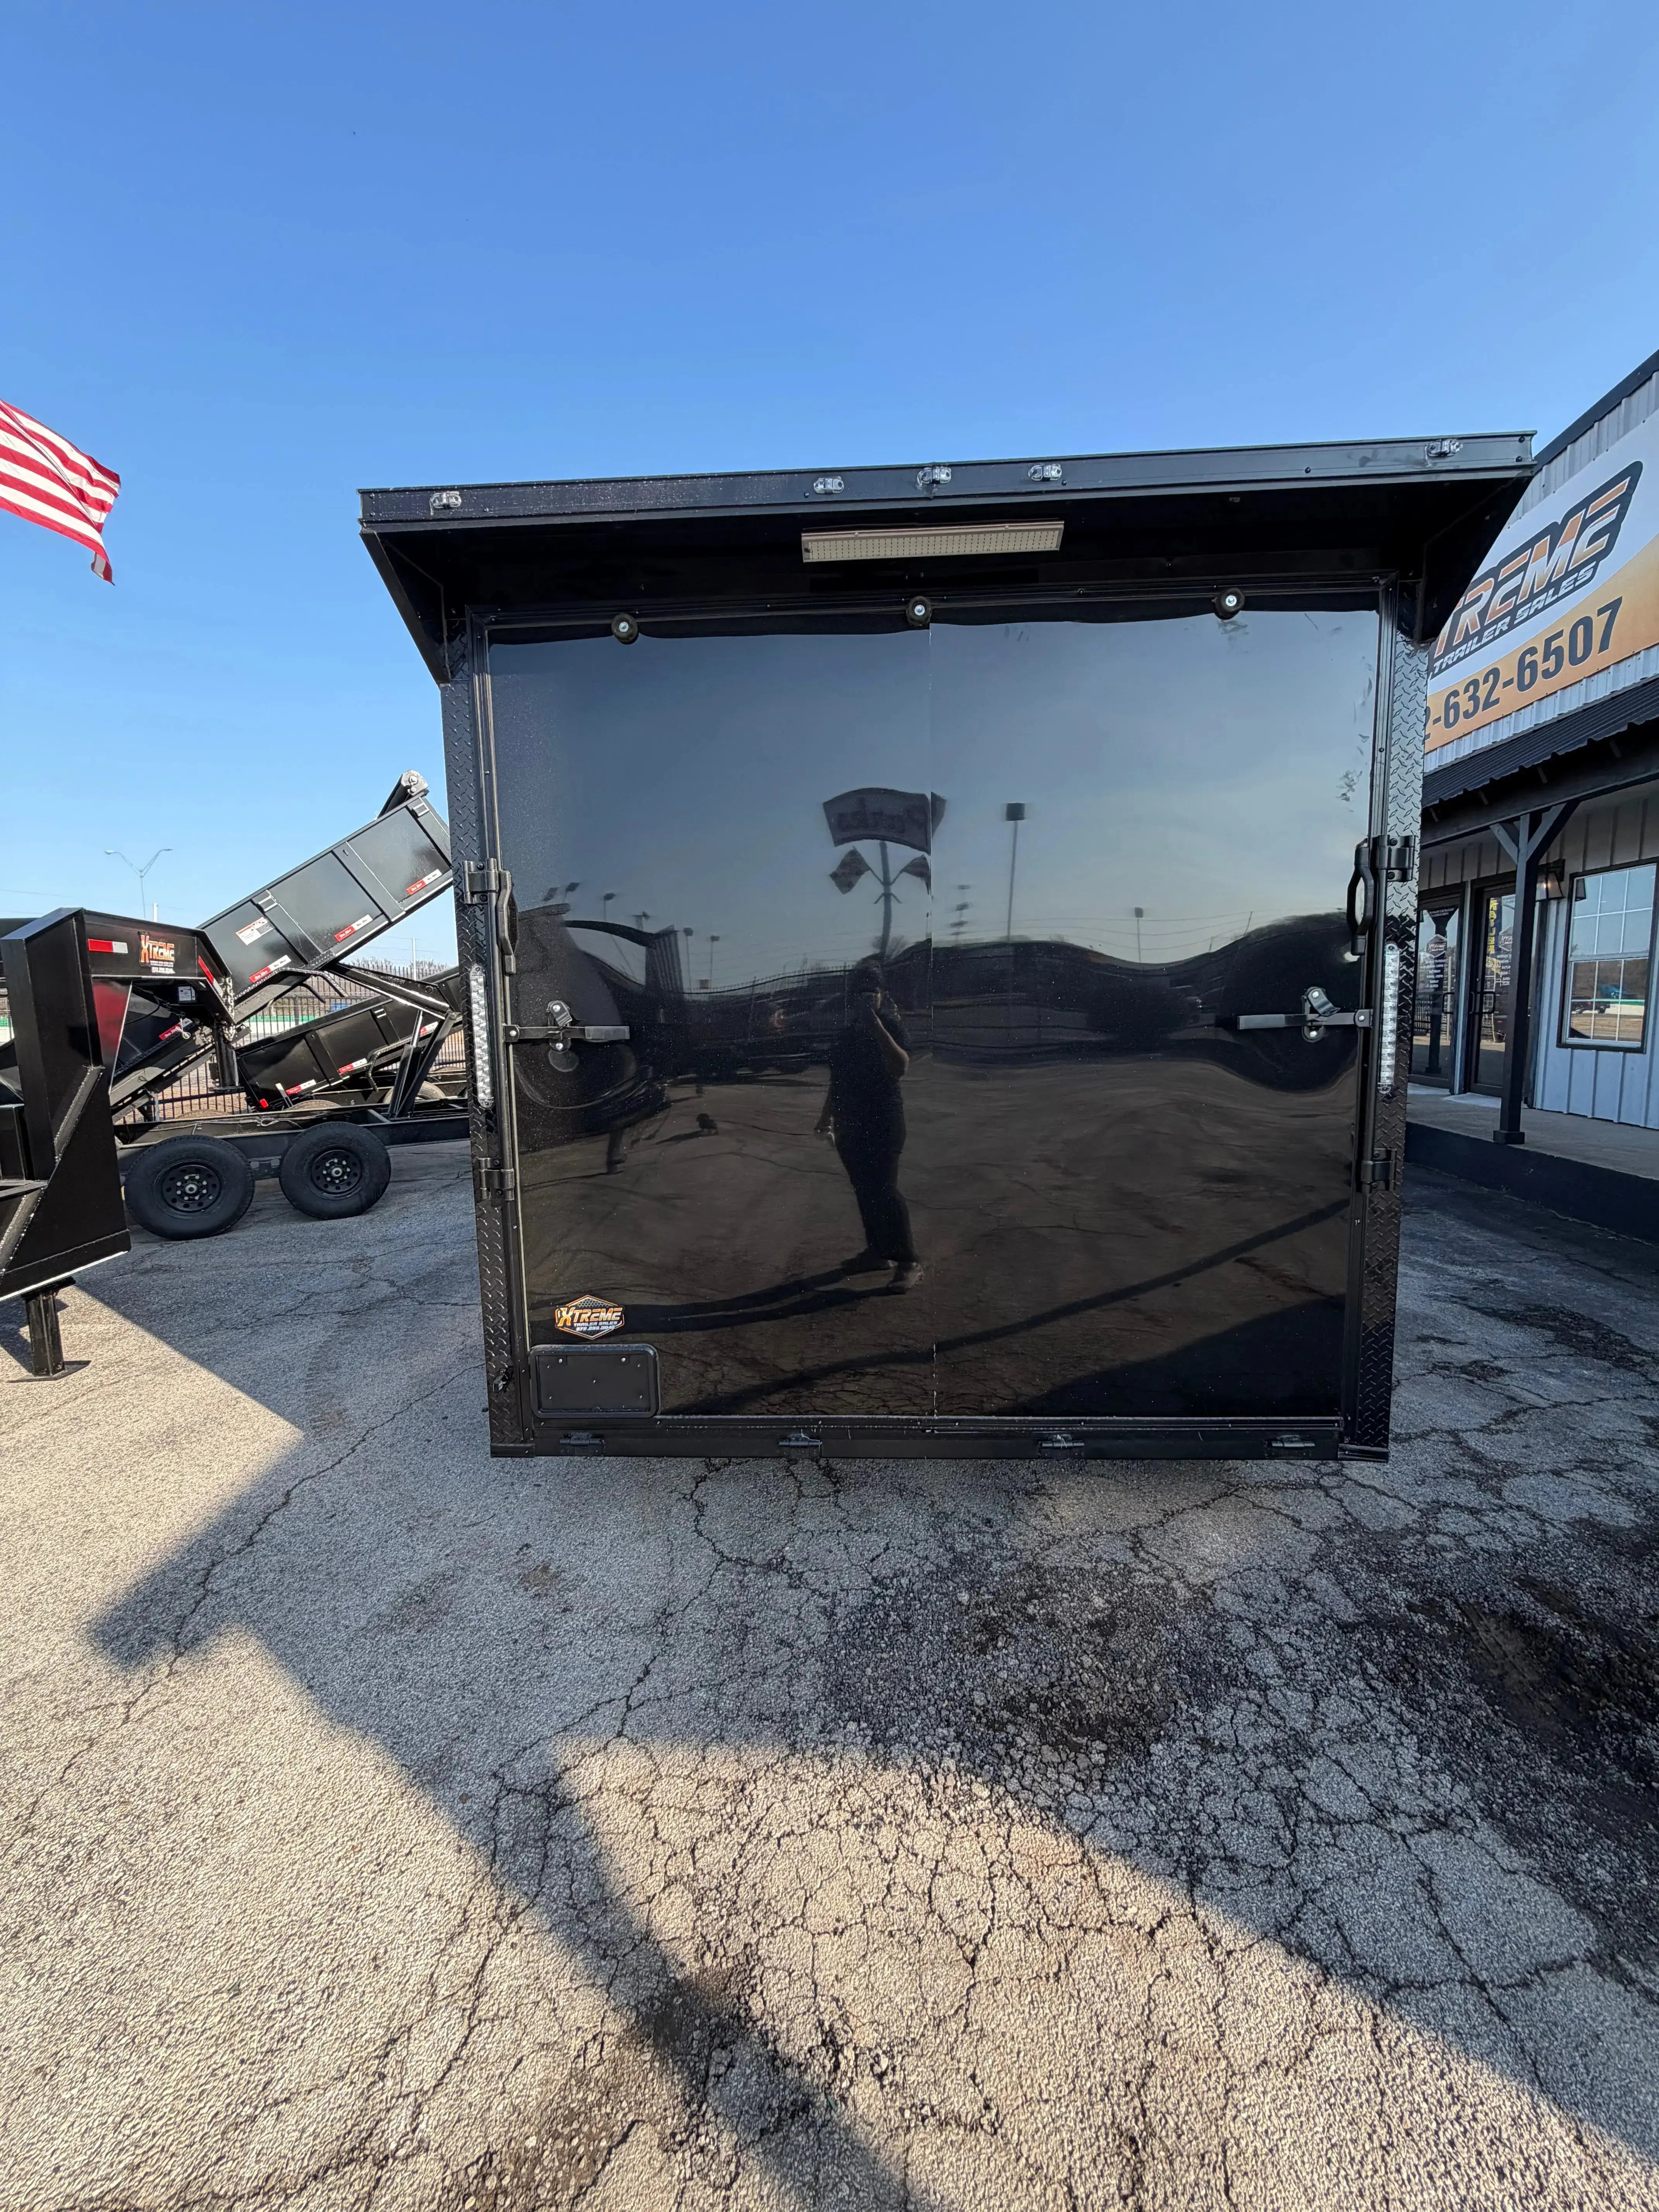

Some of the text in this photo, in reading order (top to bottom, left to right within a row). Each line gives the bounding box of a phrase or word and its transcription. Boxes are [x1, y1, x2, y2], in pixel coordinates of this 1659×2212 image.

[1433, 560, 1597, 674] TRAILER SALES
[1434, 476, 1630, 658] TREME
[557, 1307, 623, 1327] XTREME
